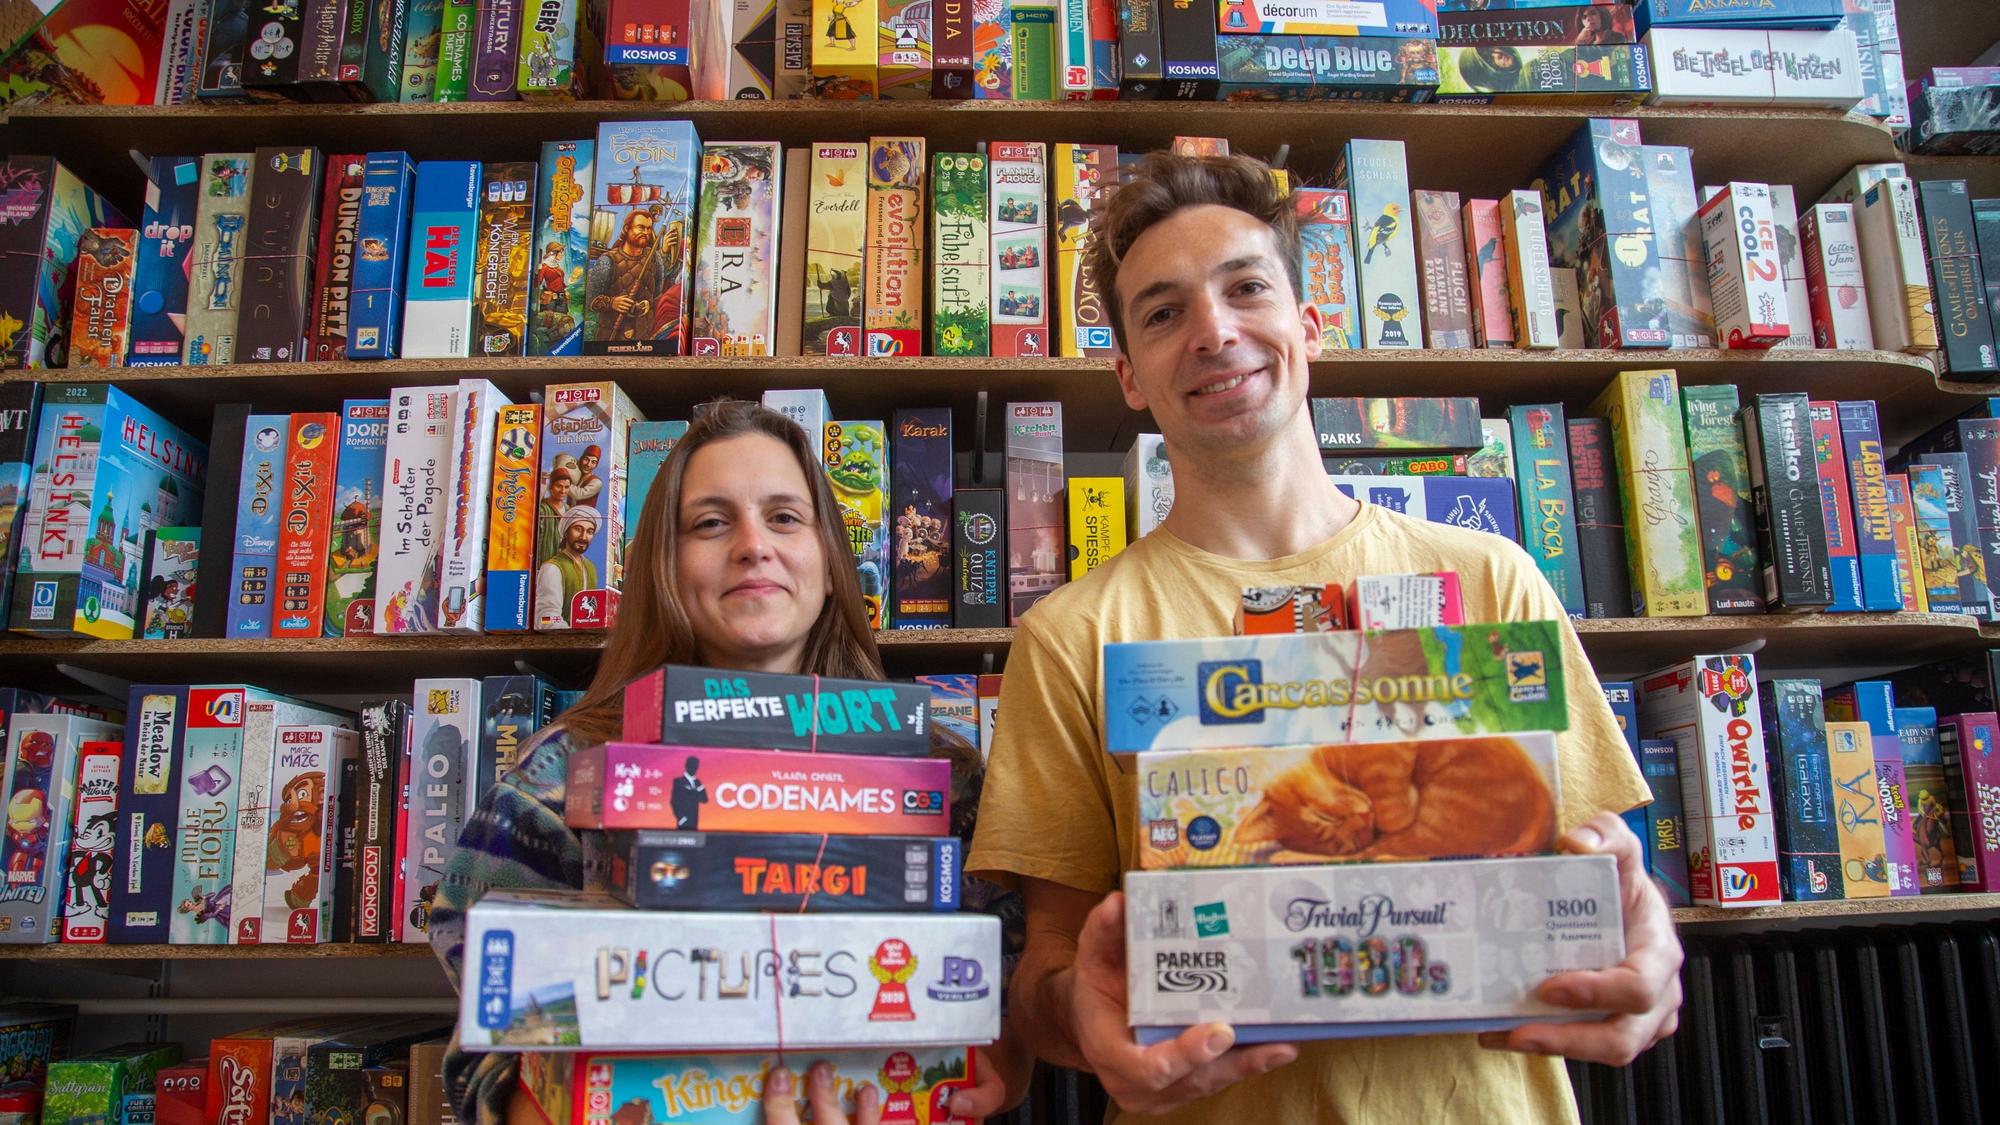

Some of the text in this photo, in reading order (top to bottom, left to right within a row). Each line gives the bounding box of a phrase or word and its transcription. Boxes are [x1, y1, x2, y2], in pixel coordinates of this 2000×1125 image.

[944, 0, 963, 41] DIA
[1262, 3, 1318, 18] décorum
[313, 6, 337, 66] Harry Potter
[445, 32, 455, 62] DUETT
[785, 24, 803, 70] CAESAR!
[1439, 20, 1565, 40] DECEPTION
[451, 13, 468, 82] CODENAMES
[621, 49, 677, 61] KOSMOS
[1264, 45, 1393, 74] Deep Blue
[1672, 47, 1842, 81] DIE INSEL DER KATZEN
[1168, 65, 1216, 76] KOSMOS
[1540, 49, 1553, 90] ROBIN
[1551, 51, 1564, 87] HOOD
[1633, 46, 1648, 90] KOSMOS
[613, 146, 677, 165] ODIN
[466, 163, 477, 209] Ravensburger
[1006, 174, 1041, 184] ROUGE
[814, 199, 862, 214] Everdell
[144, 220, 193, 241] drop
[511, 229, 519, 246] EIN
[1739, 205, 1760, 261] COOL
[159, 238, 175, 258] it
[209, 214, 245, 311] DOMINION
[328, 187, 362, 338] DUNGEON PETZ
[422, 225, 448, 288] HAI
[447, 225, 460, 288] DER WEISSE
[485, 223, 503, 300] KÖNIGREICH
[497, 215, 513, 306] WUNDERVOLLES
[875, 238, 883, 275] gefressen
[885, 194, 909, 307] evolution
[939, 219, 975, 307] Fabelsaft
[1748, 219, 1778, 283] ICE 2
[1827, 243, 1857, 255] Letter
[1828, 253, 1856, 267] Jam
[1307, 249, 1329, 305] ESELS
[1424, 259, 1437, 313] EXPRESS
[1435, 258, 1449, 315] STARLINE
[1449, 261, 1467, 315] FLUCHT
[1954, 229, 1977, 321] OATHBREAKER
[79, 285, 104, 340] Faust
[101, 272, 124, 348] Drachen
[359, 329, 377, 338] alea
[552, 326, 583, 356] Ravensburger
[607, 344, 653, 353] FEUERLAND
[867, 333, 875, 356] Schmidt
[1384, 330, 1402, 338] 2019
[1979, 344, 1994, 369] HBO
[66, 387, 88, 397] 2022
[427, 393, 435, 420] BOARD
[440, 392, 448, 419] CIRCUS
[1687, 400, 1717, 417] living
[346, 423, 389, 438] DORF
[549, 415, 604, 435] Istanbul
[902, 423, 948, 437] Karak
[1013, 422, 1057, 435] Kitchen
[1699, 413, 1735, 427] forest
[345, 437, 388, 446] ROMANTIK
[556, 434, 596, 444] BIG BOX
[1320, 432, 1362, 445] PARKS
[1408, 460, 1448, 474] CABO
[40, 415, 84, 561] HELSINKI
[251, 460, 272, 517] DiXit
[286, 459, 314, 536] DiXit
[415, 457, 442, 548] der Pagode
[496, 464, 532, 524] Indigo
[1642, 449, 1688, 526] Granja
[1859, 439, 1892, 541] LABYRINTH
[394, 466, 416, 556] Im Schatten
[1534, 458, 1567, 560] LA BOCA
[1821, 477, 1843, 548] LABYRINTH
[241, 535, 276, 550] Disney
[848, 527, 874, 544] STER
[1099, 514, 1111, 551] KAMPF
[1781, 509, 1795, 574] GEFECHT-EDITION
[255, 567, 267, 577] 3-6
[256, 582, 265, 590] 8+
[970, 553, 984, 592] QUIZ
[985, 549, 996, 606] KNEIPEN
[1849, 558, 1861, 608] Ravensburger
[1890, 558, 1901, 604] Ravensburger
[516, 573, 527, 627] Ravensburger
[1716, 599, 1755, 609] Ludonaute
[703, 677, 751, 699] DAS
[1205, 665, 1476, 721] Carcassonne
[1711, 674, 1720, 691] 2011
[231, 693, 241, 723] Schmidt
[673, 696, 785, 724] PERFEKTE
[785, 687, 902, 737] WORT
[914, 701, 924, 736] moses.
[1883, 684, 1895, 732] Ravensburger
[138, 710, 151, 778] Im Reich der Natur
[148, 711, 173, 778] Meadow
[289, 746, 312, 755] MAGIC
[1644, 746, 1674, 754] KOSMOS
[1907, 735, 1924, 745] BET
[281, 753, 319, 768] MAZE
[1718, 734, 1729, 795] EINFACH BEGONNEN
[1726, 717, 1761, 833] Qwirkle
[79, 778, 120, 795] MASTER
[86, 786, 111, 797] Word
[715, 782, 896, 815] CODENAMES
[1147, 766, 1249, 798] CALICO
[1889, 783, 1906, 810] krazy
[423, 754, 450, 865] PALEO
[1877, 776, 1898, 823] WORDZ
[240, 816, 264, 827] MACRO
[1151, 826, 1178, 843] AEG
[1657, 817, 1681, 852] PARIS
[199, 801, 228, 881] FIORI
[8, 870, 36, 883] MARVEL
[364, 848, 380, 934] MONOPOLY
[733, 855, 867, 896] TARGI
[940, 844, 953, 904] KOSMOS
[1722, 867, 1730, 898] Schmidt
[1927, 871, 1943, 882] AEG
[1283, 893, 1448, 938] Trivial Pursuit
[1546, 898, 1598, 918] 1800
[1545, 920, 1599, 931] Questions
[595, 947, 857, 1002] PICTURES
[1156, 951, 1227, 969] PARKER
[1290, 936, 1451, 1000] 1980s
[880, 993, 905, 1004] 2020
[887, 1101, 909, 1112] 2017
